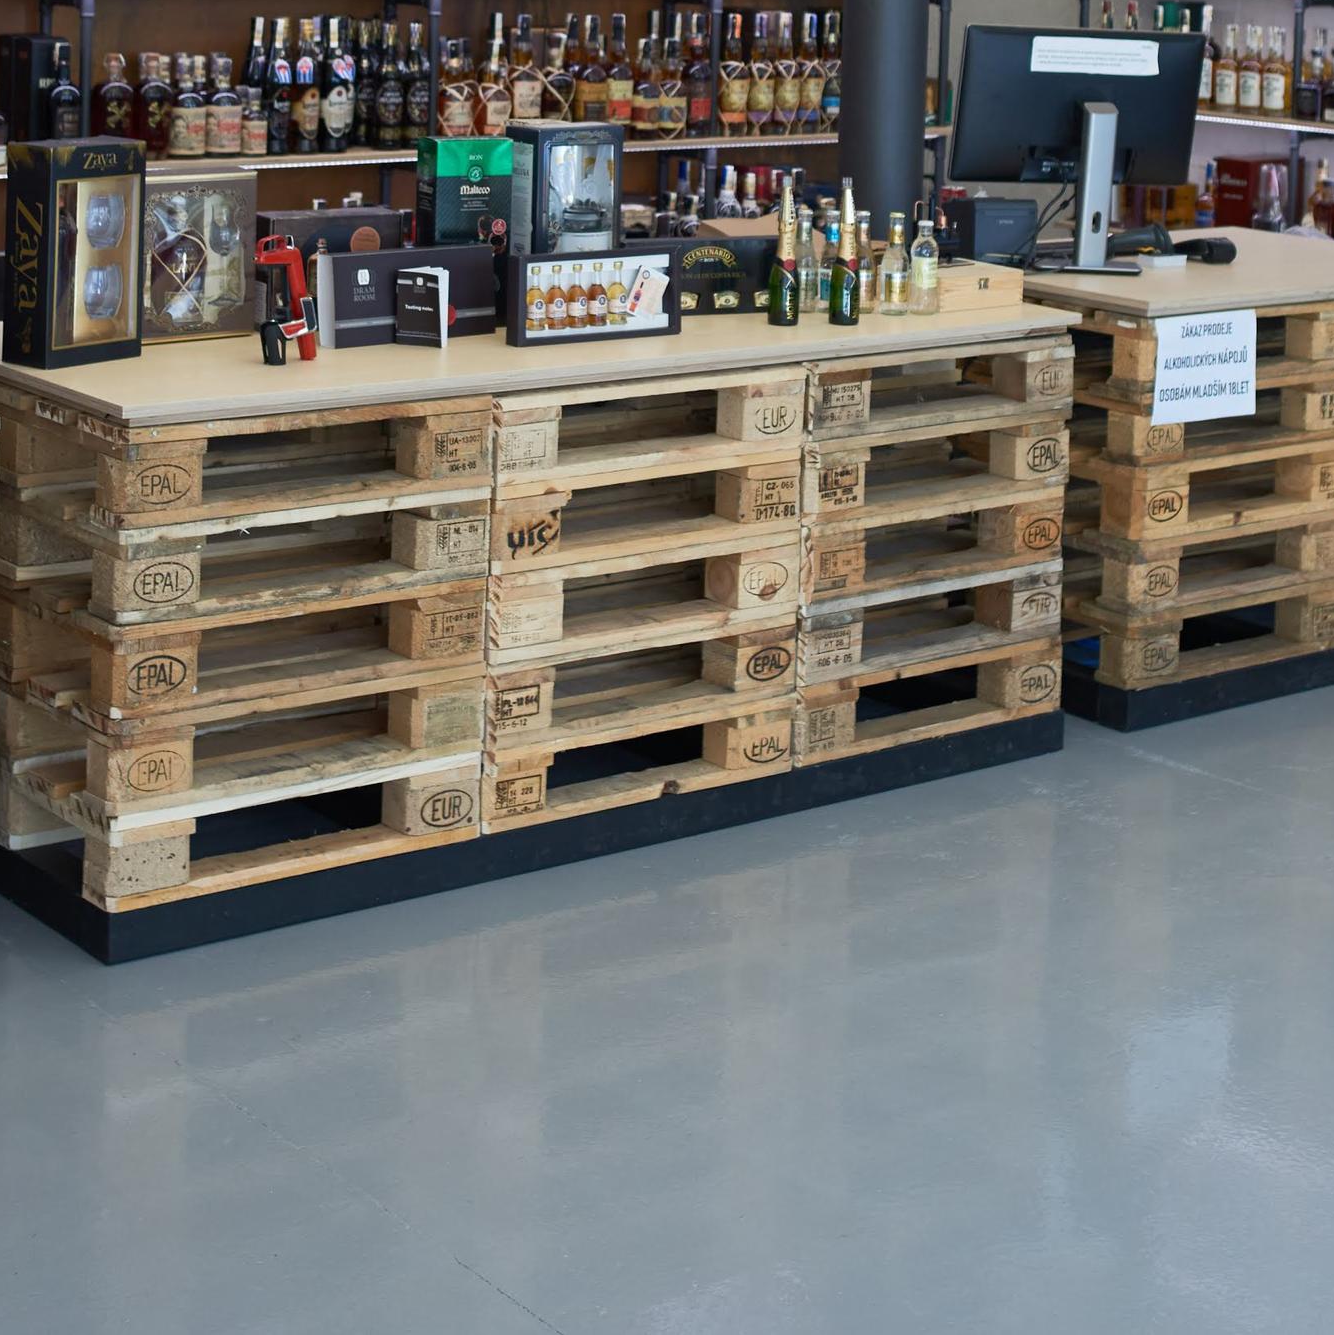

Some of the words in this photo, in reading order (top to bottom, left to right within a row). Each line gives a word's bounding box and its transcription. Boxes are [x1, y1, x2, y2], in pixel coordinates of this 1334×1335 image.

[83, 151, 118, 171] Zaya
[460, 185, 491, 195] Malteco
[10, 196, 44, 314] Zaya
[685, 246, 733, 263] CENTENARIO
[353, 286, 376, 295] DRAM
[353, 294, 376, 302] ROOM
[1181, 322, 1202, 339] ZÁKAZ
[1203, 321, 1233, 337] PRODEJE
[1164, 351, 1217, 371] ALKOHOLICKÝCH
[1218, 345, 1248, 365] NÁPOJŮ
[1159, 383, 1192, 403] OSOBÁM
[1192, 379, 1227, 399] MLADŠÍM
[1228, 380, 1250, 395] 18LET
[762, 406, 788, 429] EUR
[1032, 442, 1060, 466] EPAL
[140, 469, 183, 496] EPAL
[1151, 496, 1178, 515] EPAL
[1027, 522, 1055, 542] EPAL
[141, 568, 185, 596] EPAL
[135, 660, 180, 689] EPAL
[753, 650, 789, 676] EPAL
[1020, 669, 1053, 693] EPAL
[431, 795, 461, 821] EUR
